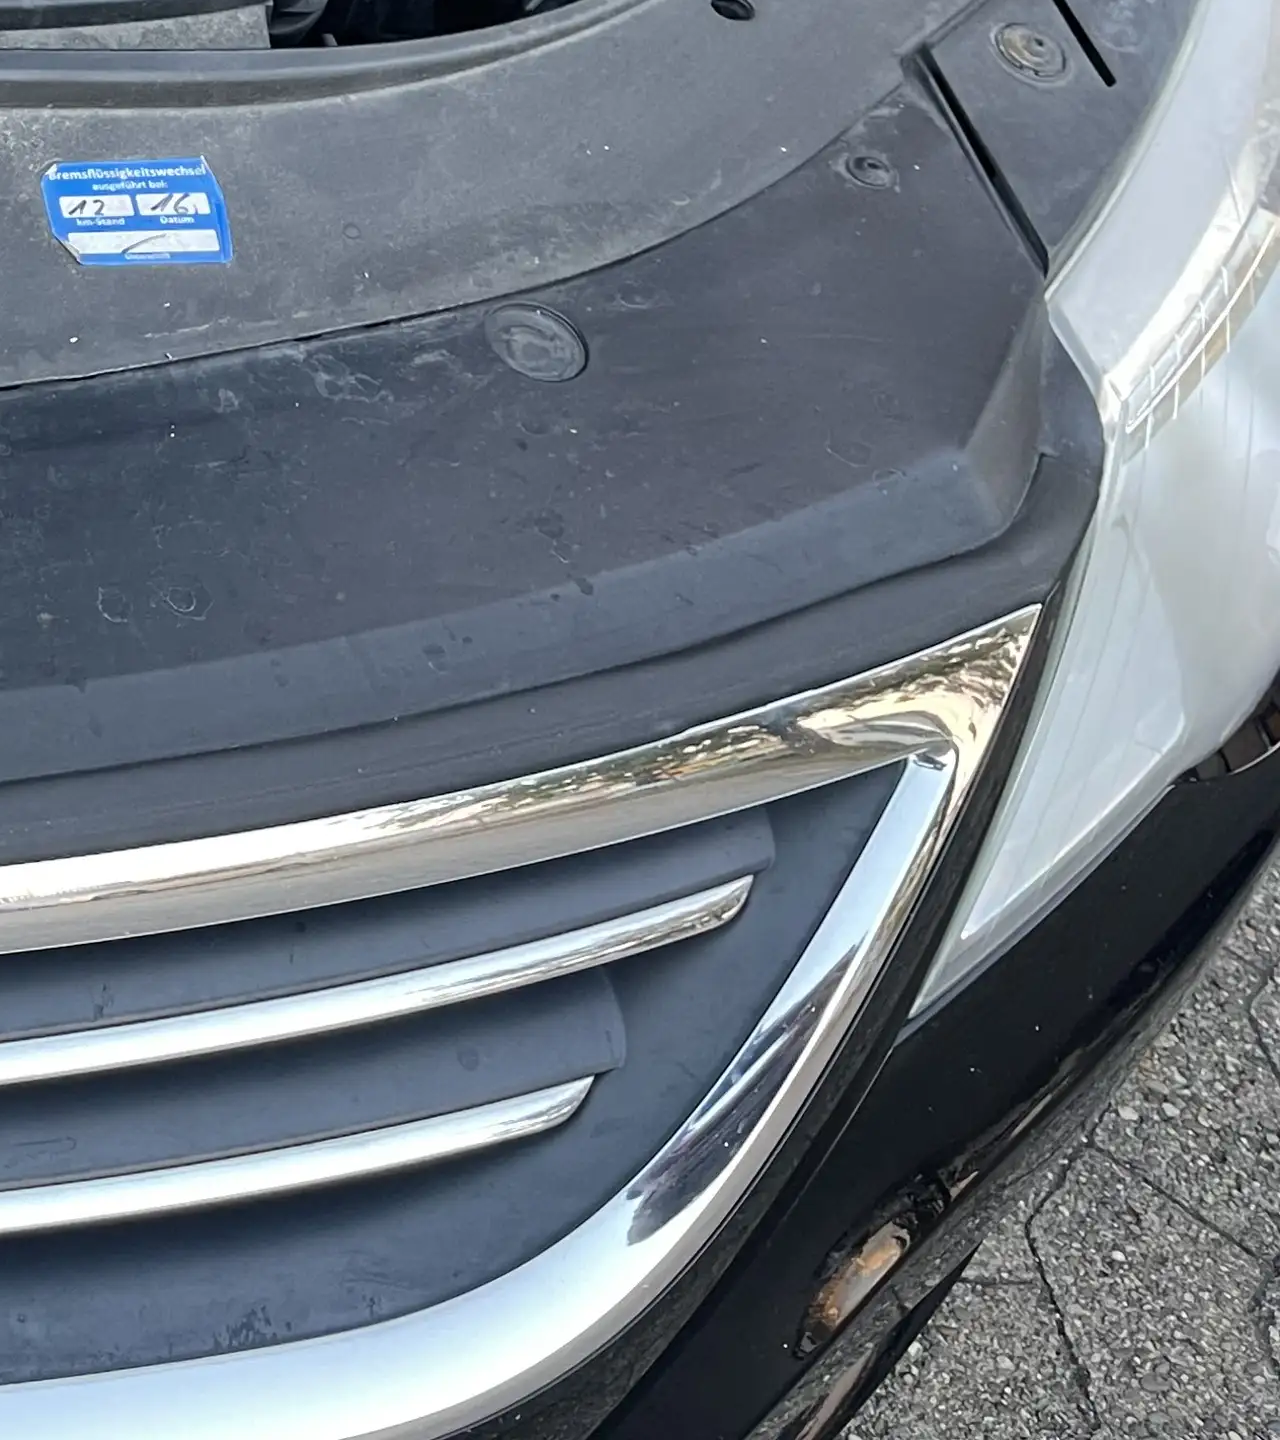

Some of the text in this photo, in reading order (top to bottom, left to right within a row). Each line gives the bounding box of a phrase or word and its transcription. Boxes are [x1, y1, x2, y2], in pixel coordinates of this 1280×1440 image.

[92, 180, 146, 191] ausgeführt
[68, 199, 105, 216] 12
[76, 217, 126, 227] km-Stand
[160, 215, 196, 225] Datum
